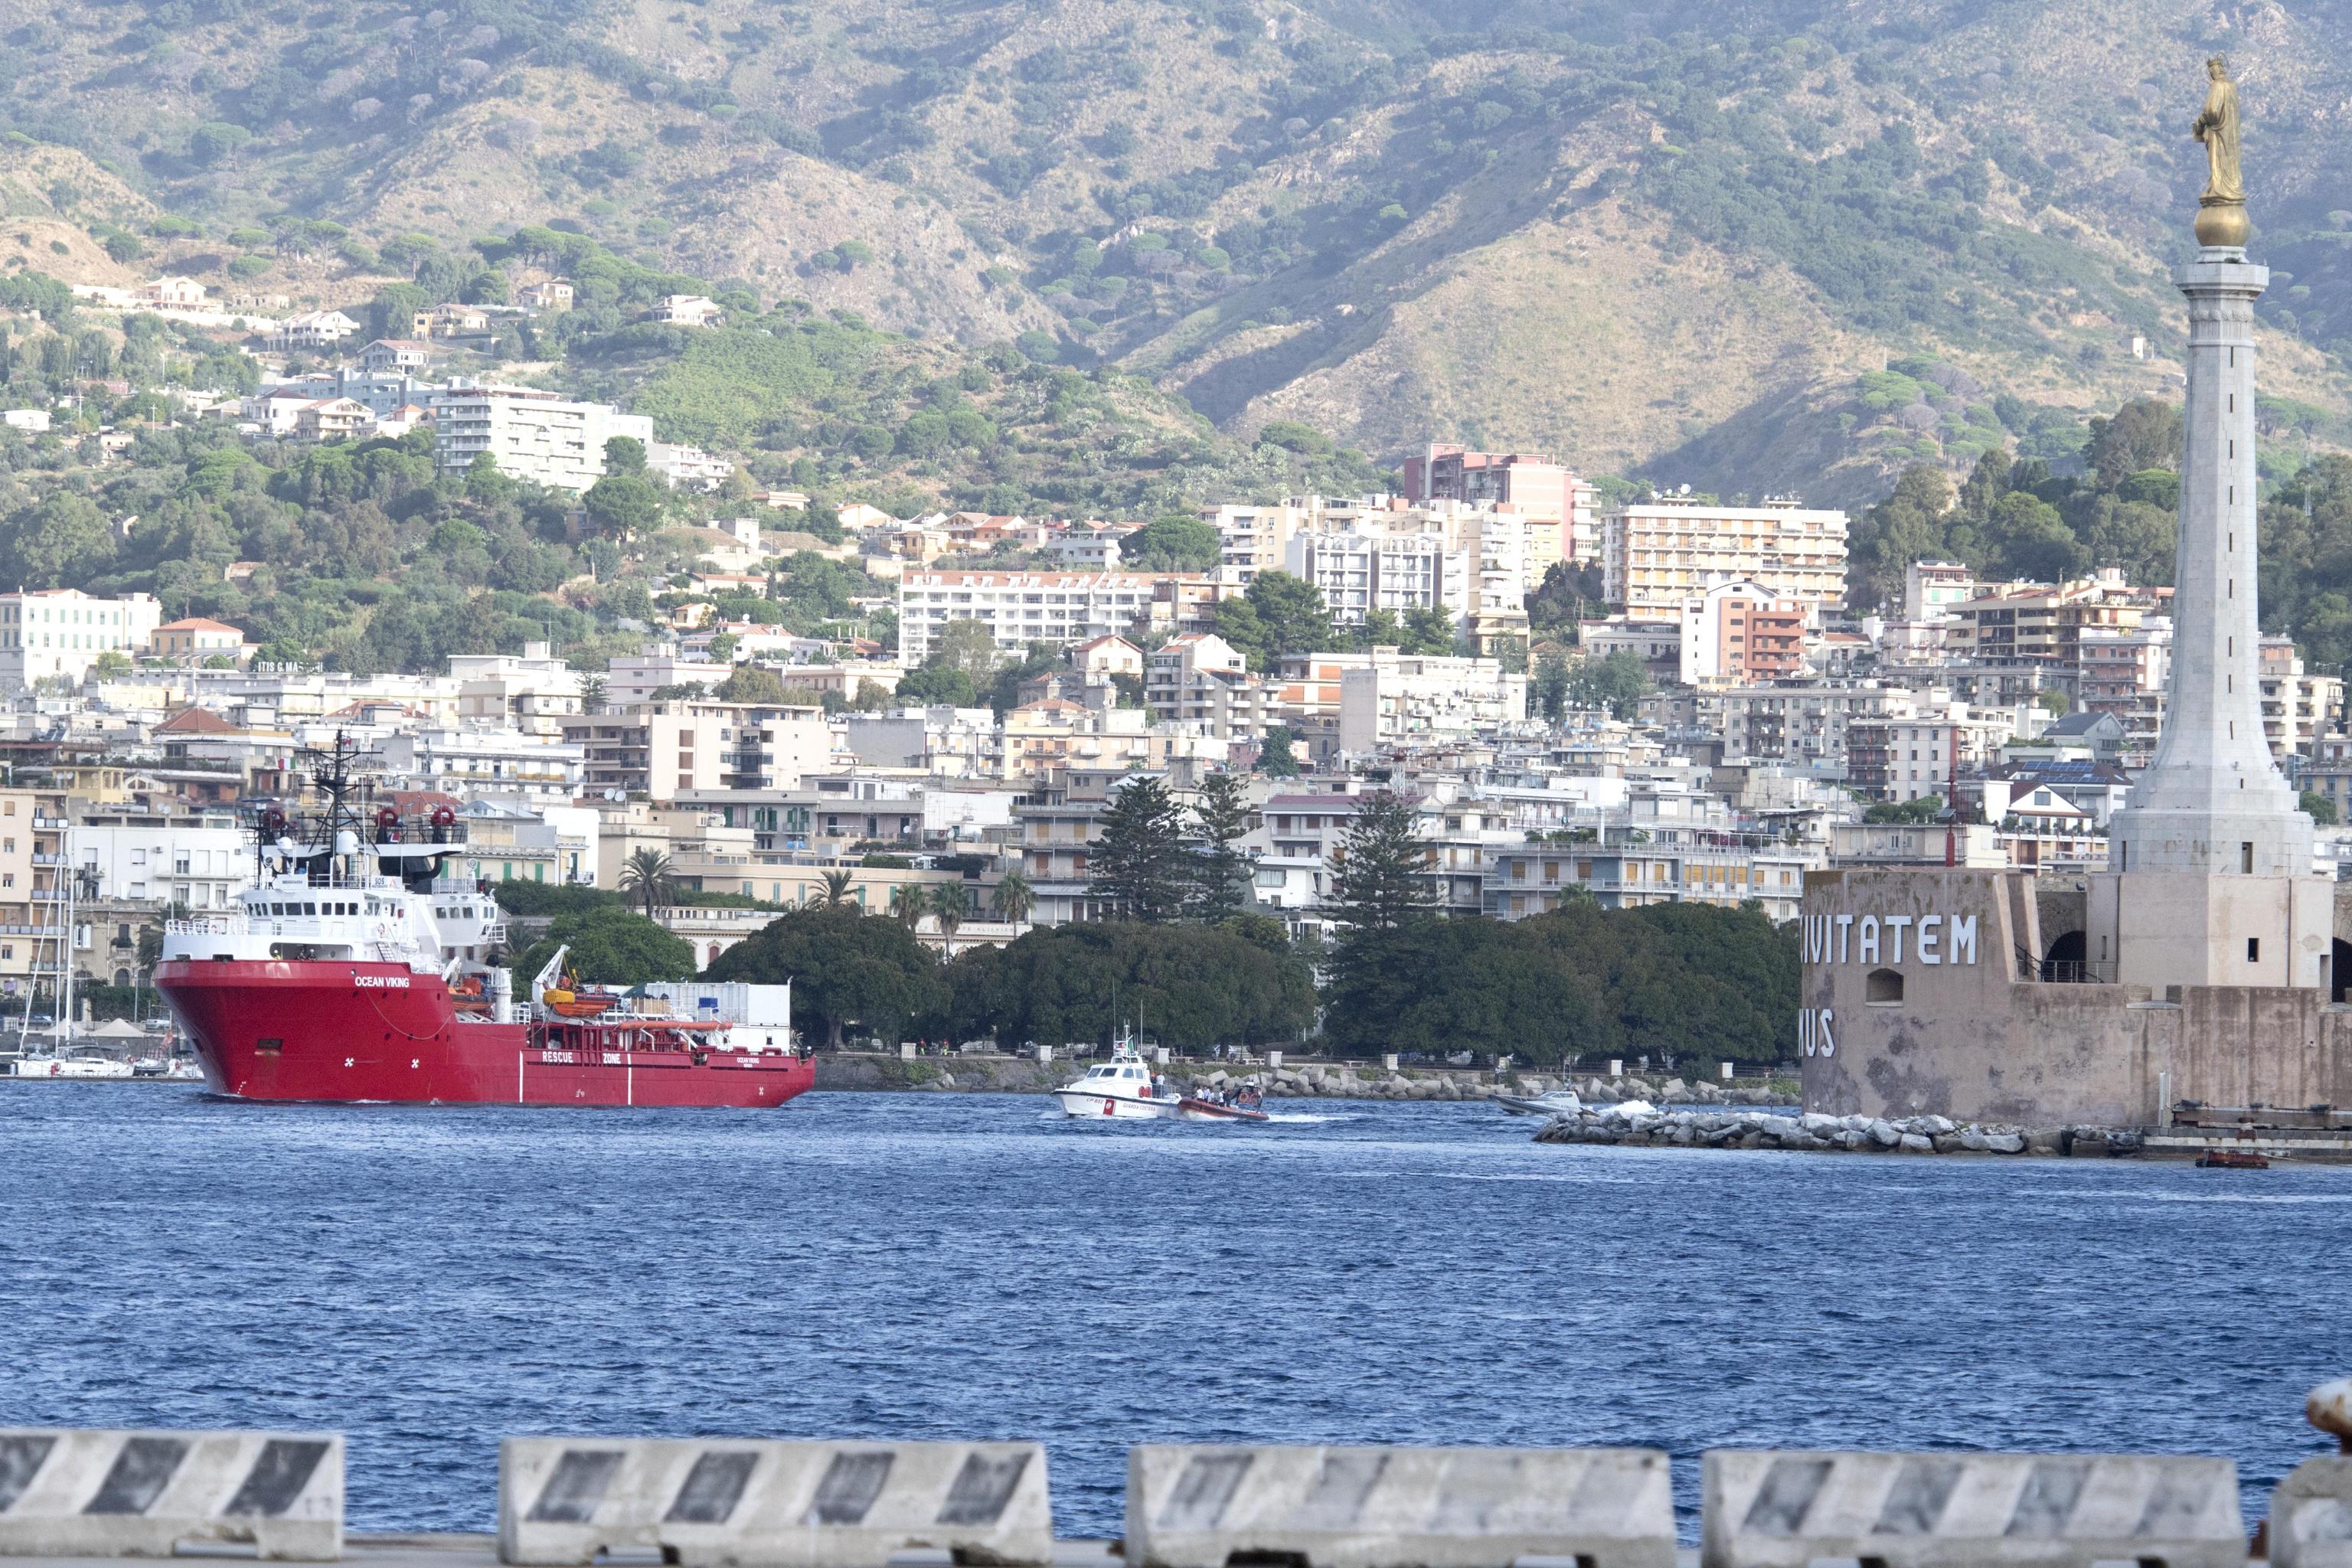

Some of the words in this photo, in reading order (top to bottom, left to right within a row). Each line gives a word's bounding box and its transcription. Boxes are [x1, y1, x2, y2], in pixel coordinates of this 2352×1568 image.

[258, 661, 275, 672] ITIS
[354, 976, 384, 987] OCEAN
[385, 977, 410, 988] VIKING
[542, 1051, 573, 1063] RESCUE
[603, 1053, 621, 1064] ZONE
